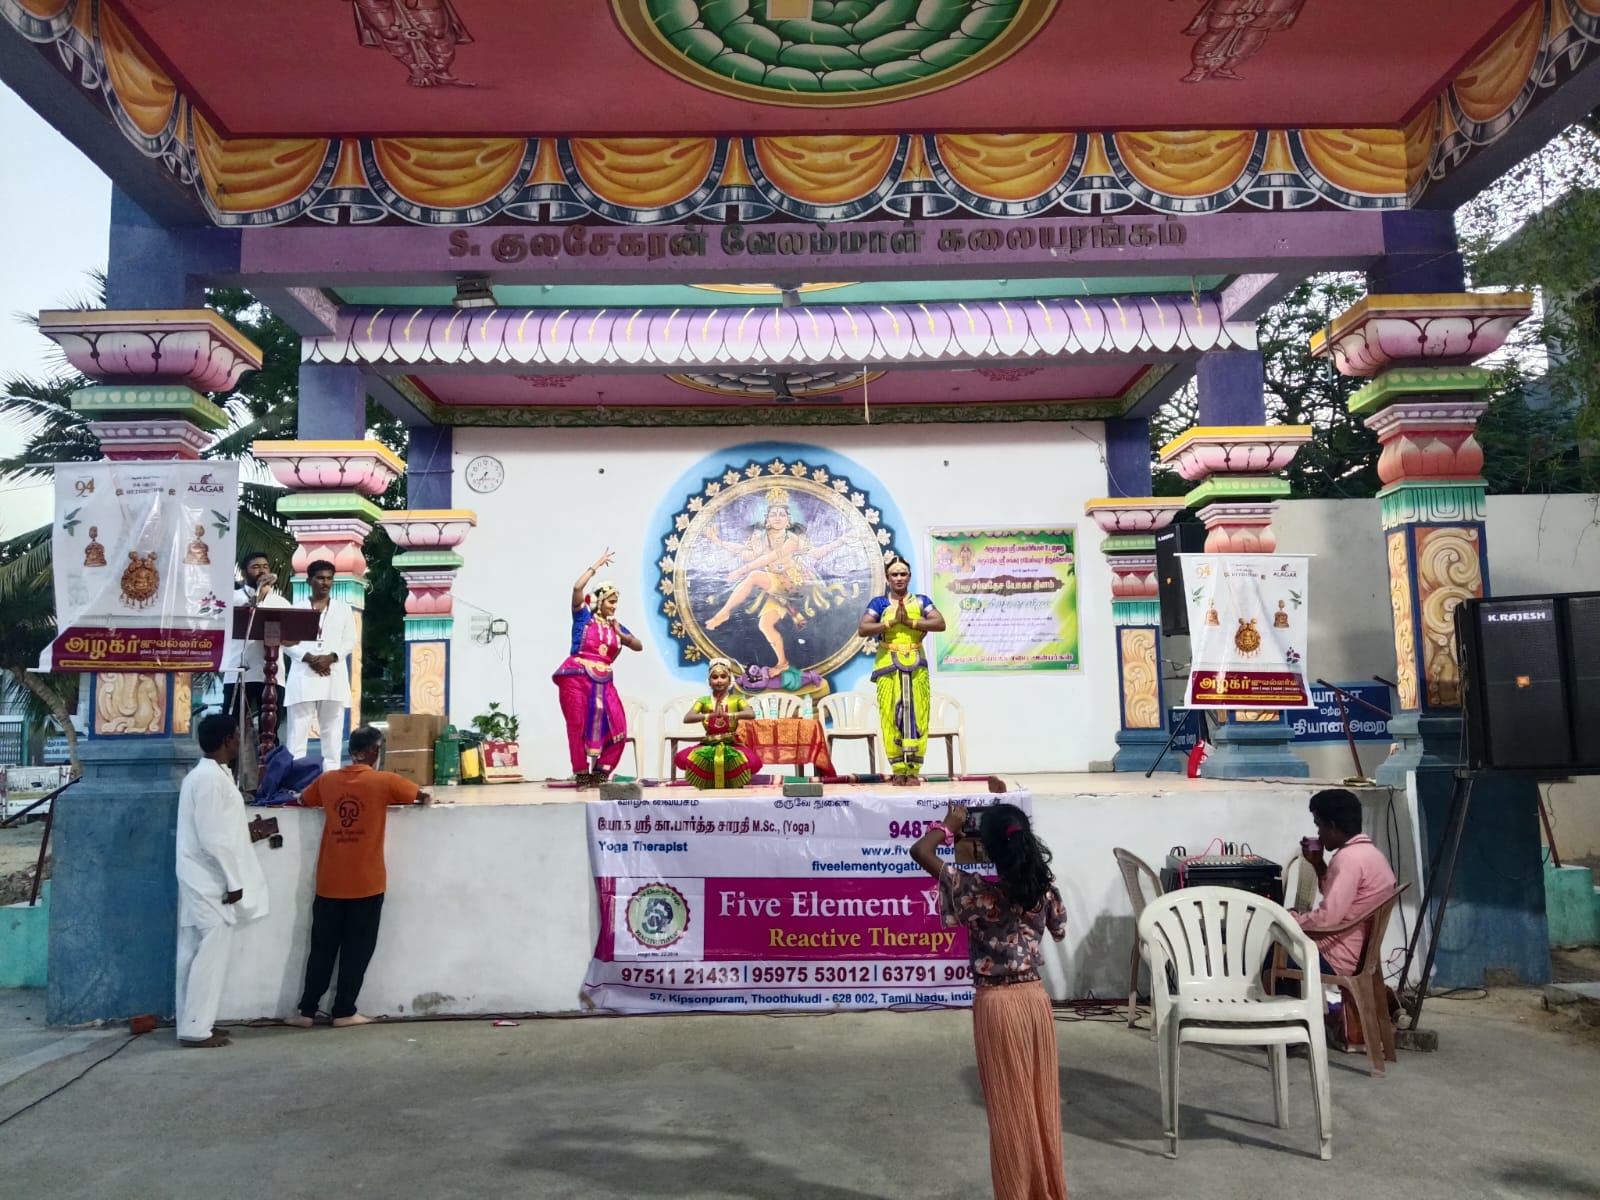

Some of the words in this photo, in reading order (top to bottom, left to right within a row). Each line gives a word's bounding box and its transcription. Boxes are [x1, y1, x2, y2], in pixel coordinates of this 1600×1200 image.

[449, 229, 480, 257] S.
[491, 222, 708, 263] குலசேகரன்
[720, 220, 925, 256] வேலம்மாள்
[937, 214, 1187, 253] கலையரங்கம்
[187, 484, 224, 494] ALAGAR
[1488, 612, 1546, 622] K.RAJESH
[65, 634, 140, 660] அழகர்
[598, 841, 628, 853] Yoga
[632, 841, 688, 853] Therapist
[719, 891, 781, 917] Five
[791, 890, 913, 917] Element
[769, 928, 861, 948] Reactive
[868, 927, 956, 952] Therapy
[621, 968, 676, 984] 97511
[684, 967, 740, 984] 21433
[752, 966, 808, 983] 95975
[815, 966, 870, 983] 53012
[882, 965, 936, 983] 63791
[751, 992, 822, 1004] Thoothukudi
[832, 993, 851, 1004] 628
[855, 993, 878, 1005] 002,
[882, 992, 912, 1004] Tamil
[915, 991, 948, 1003] Nadu,
